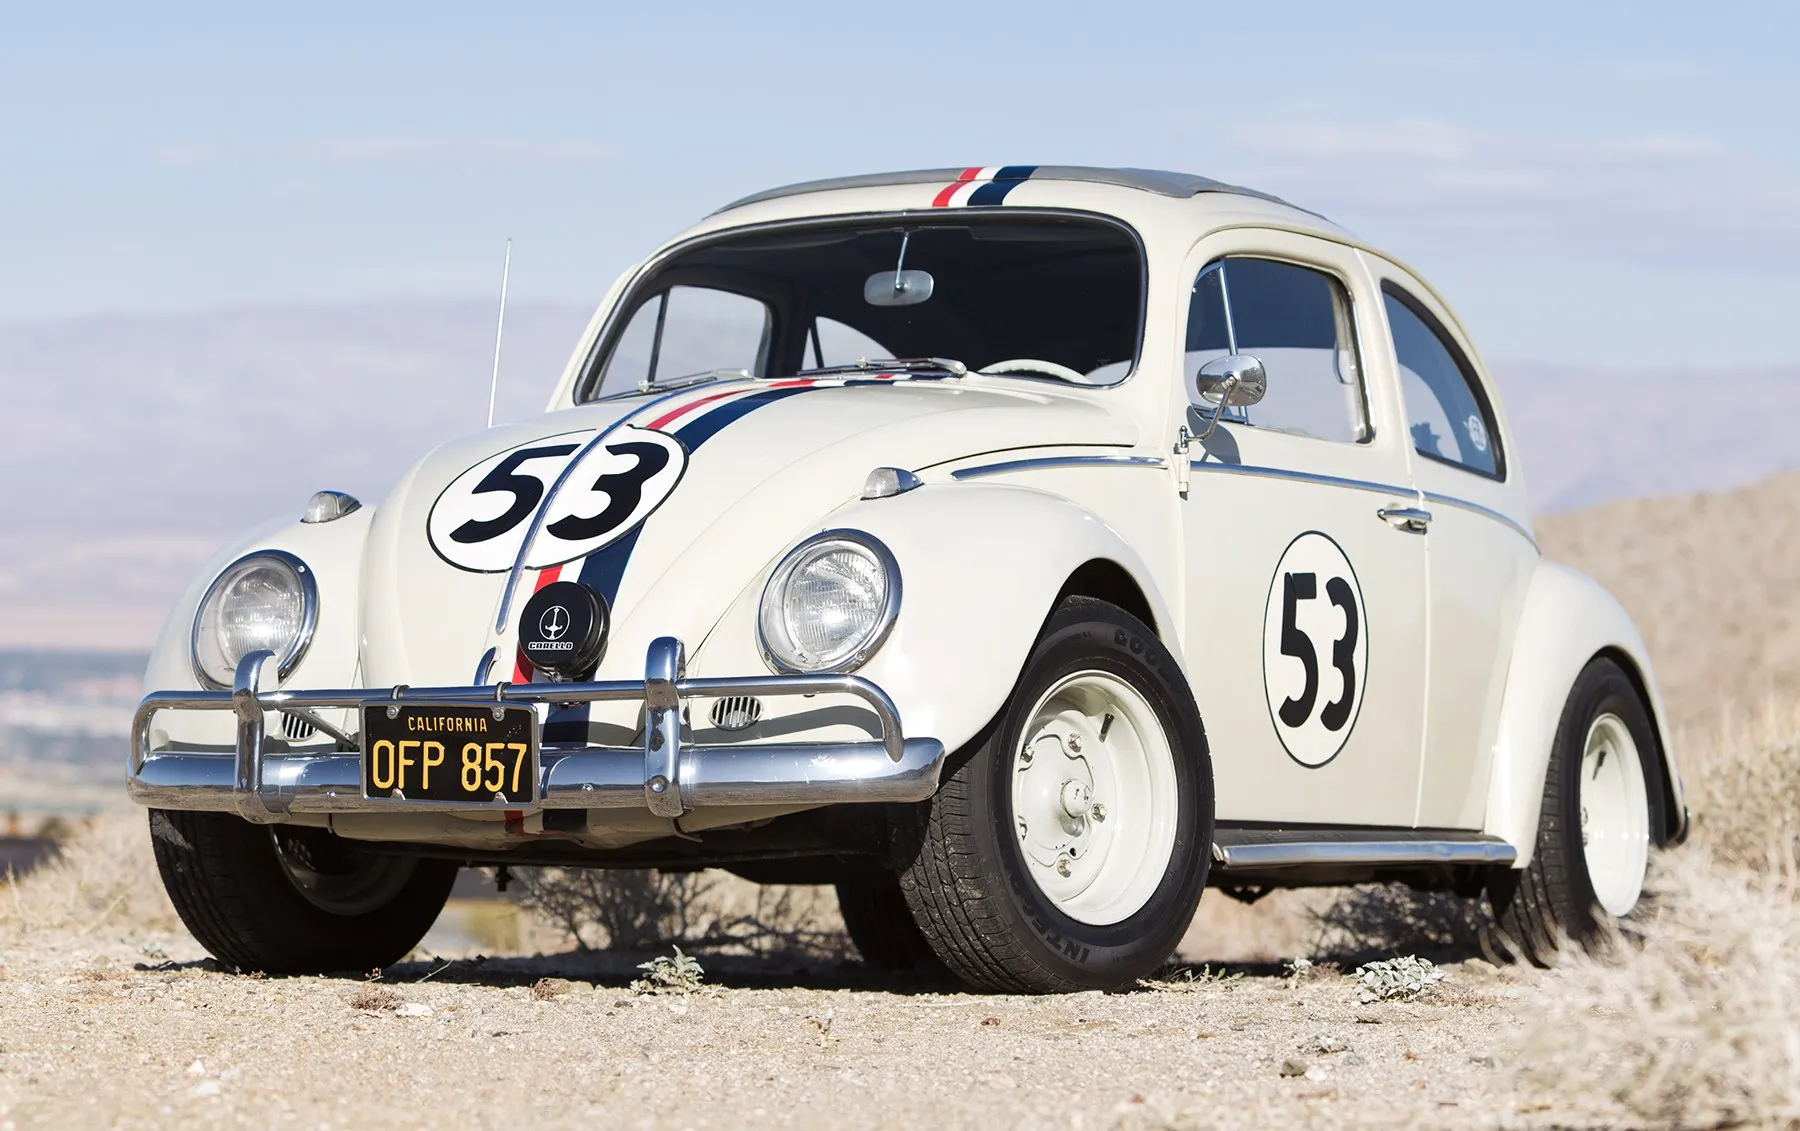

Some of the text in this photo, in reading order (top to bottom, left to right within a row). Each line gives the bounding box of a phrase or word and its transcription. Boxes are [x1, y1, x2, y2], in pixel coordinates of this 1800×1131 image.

[449, 442, 669, 543] 53
[528, 642, 573, 650] CARELLO
[1279, 572, 1358, 731] 53
[407, 716, 488, 732] CALIFORNIA
[373, 740, 527, 793] OFP 857
